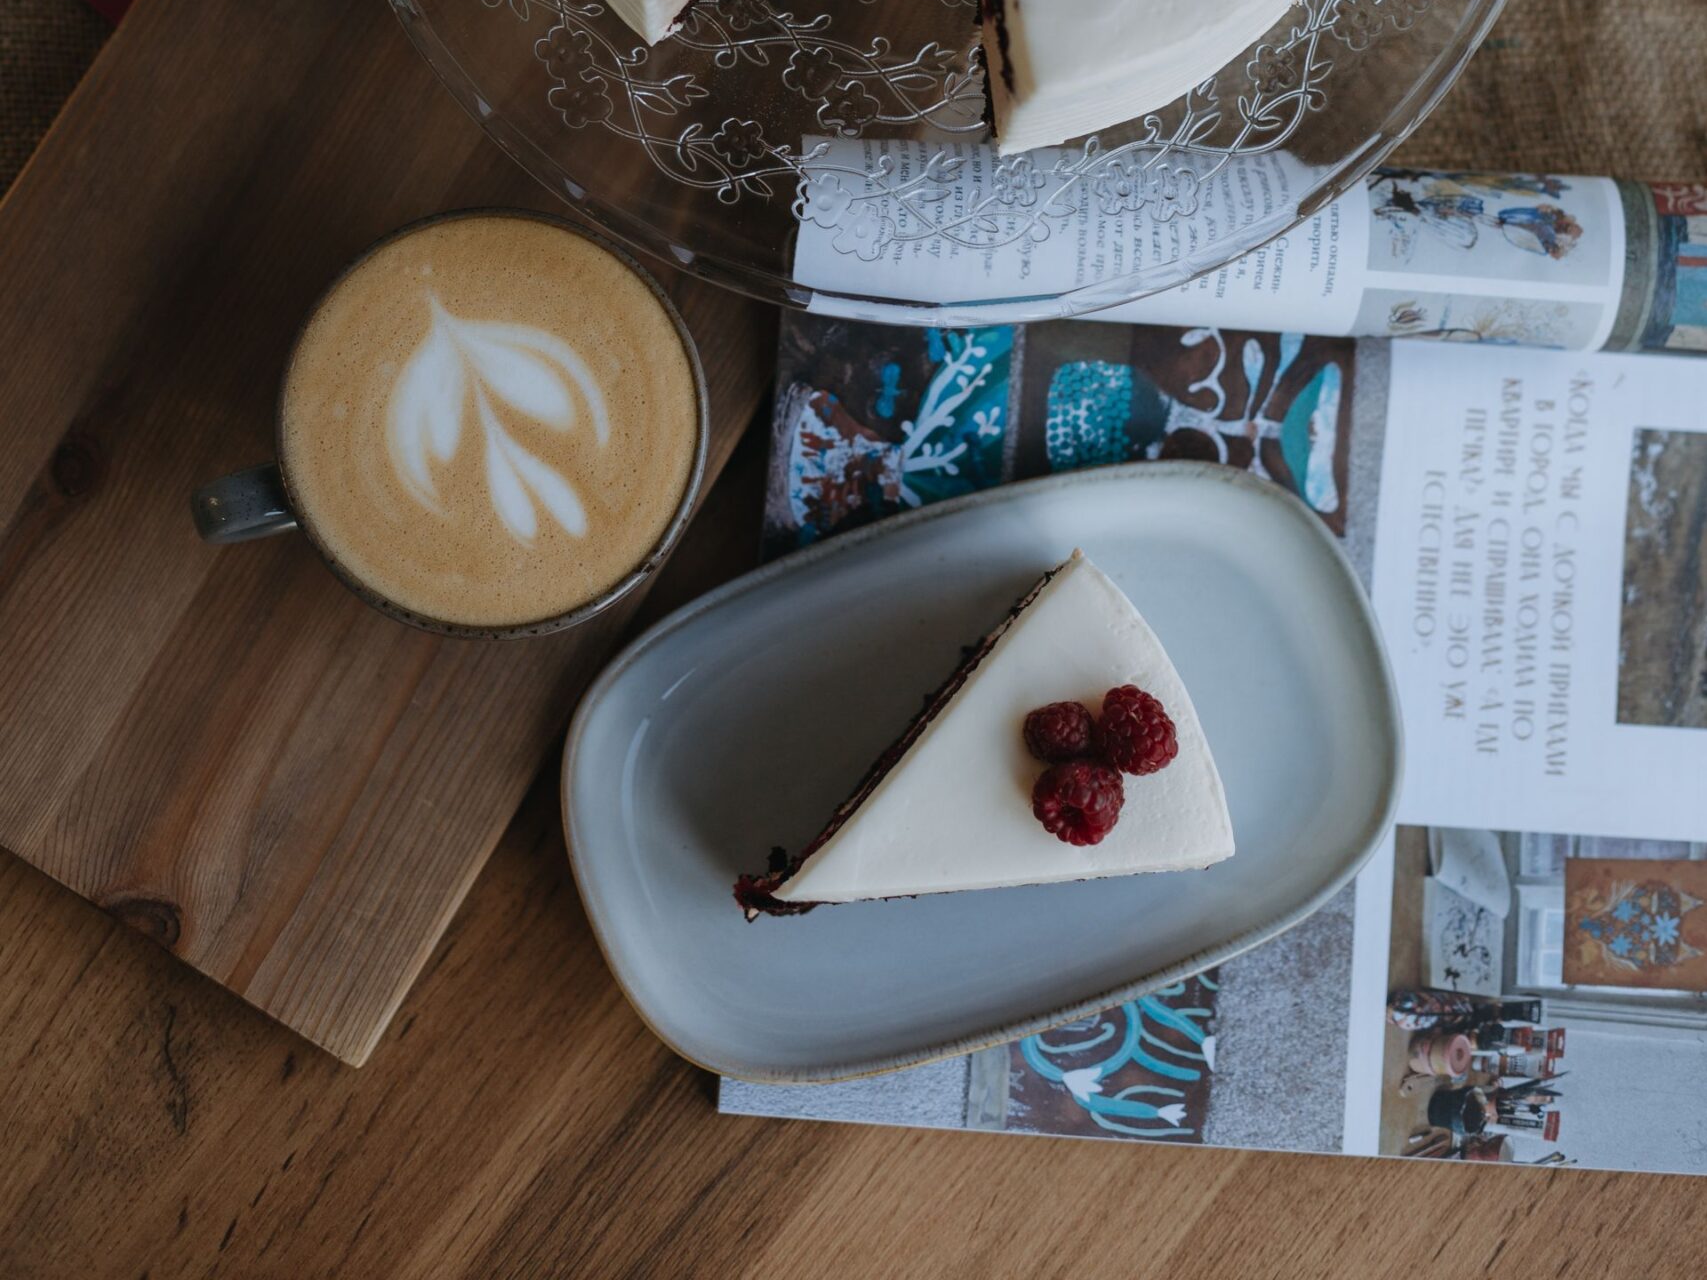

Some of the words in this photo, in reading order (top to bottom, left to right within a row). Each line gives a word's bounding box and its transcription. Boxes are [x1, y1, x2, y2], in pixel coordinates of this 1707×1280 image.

[1534, 399, 1555, 412] В
[1491, 492, 1512, 506] И
[1555, 511, 1576, 532] С
[1520, 527, 1543, 581] ОНА
[1446, 614, 1468, 668] ЭТО
[1514, 594, 1539, 687] ХОДИЛА
[1512, 699, 1534, 742] ПО
[1476, 723, 1499, 758] ГДЕ
